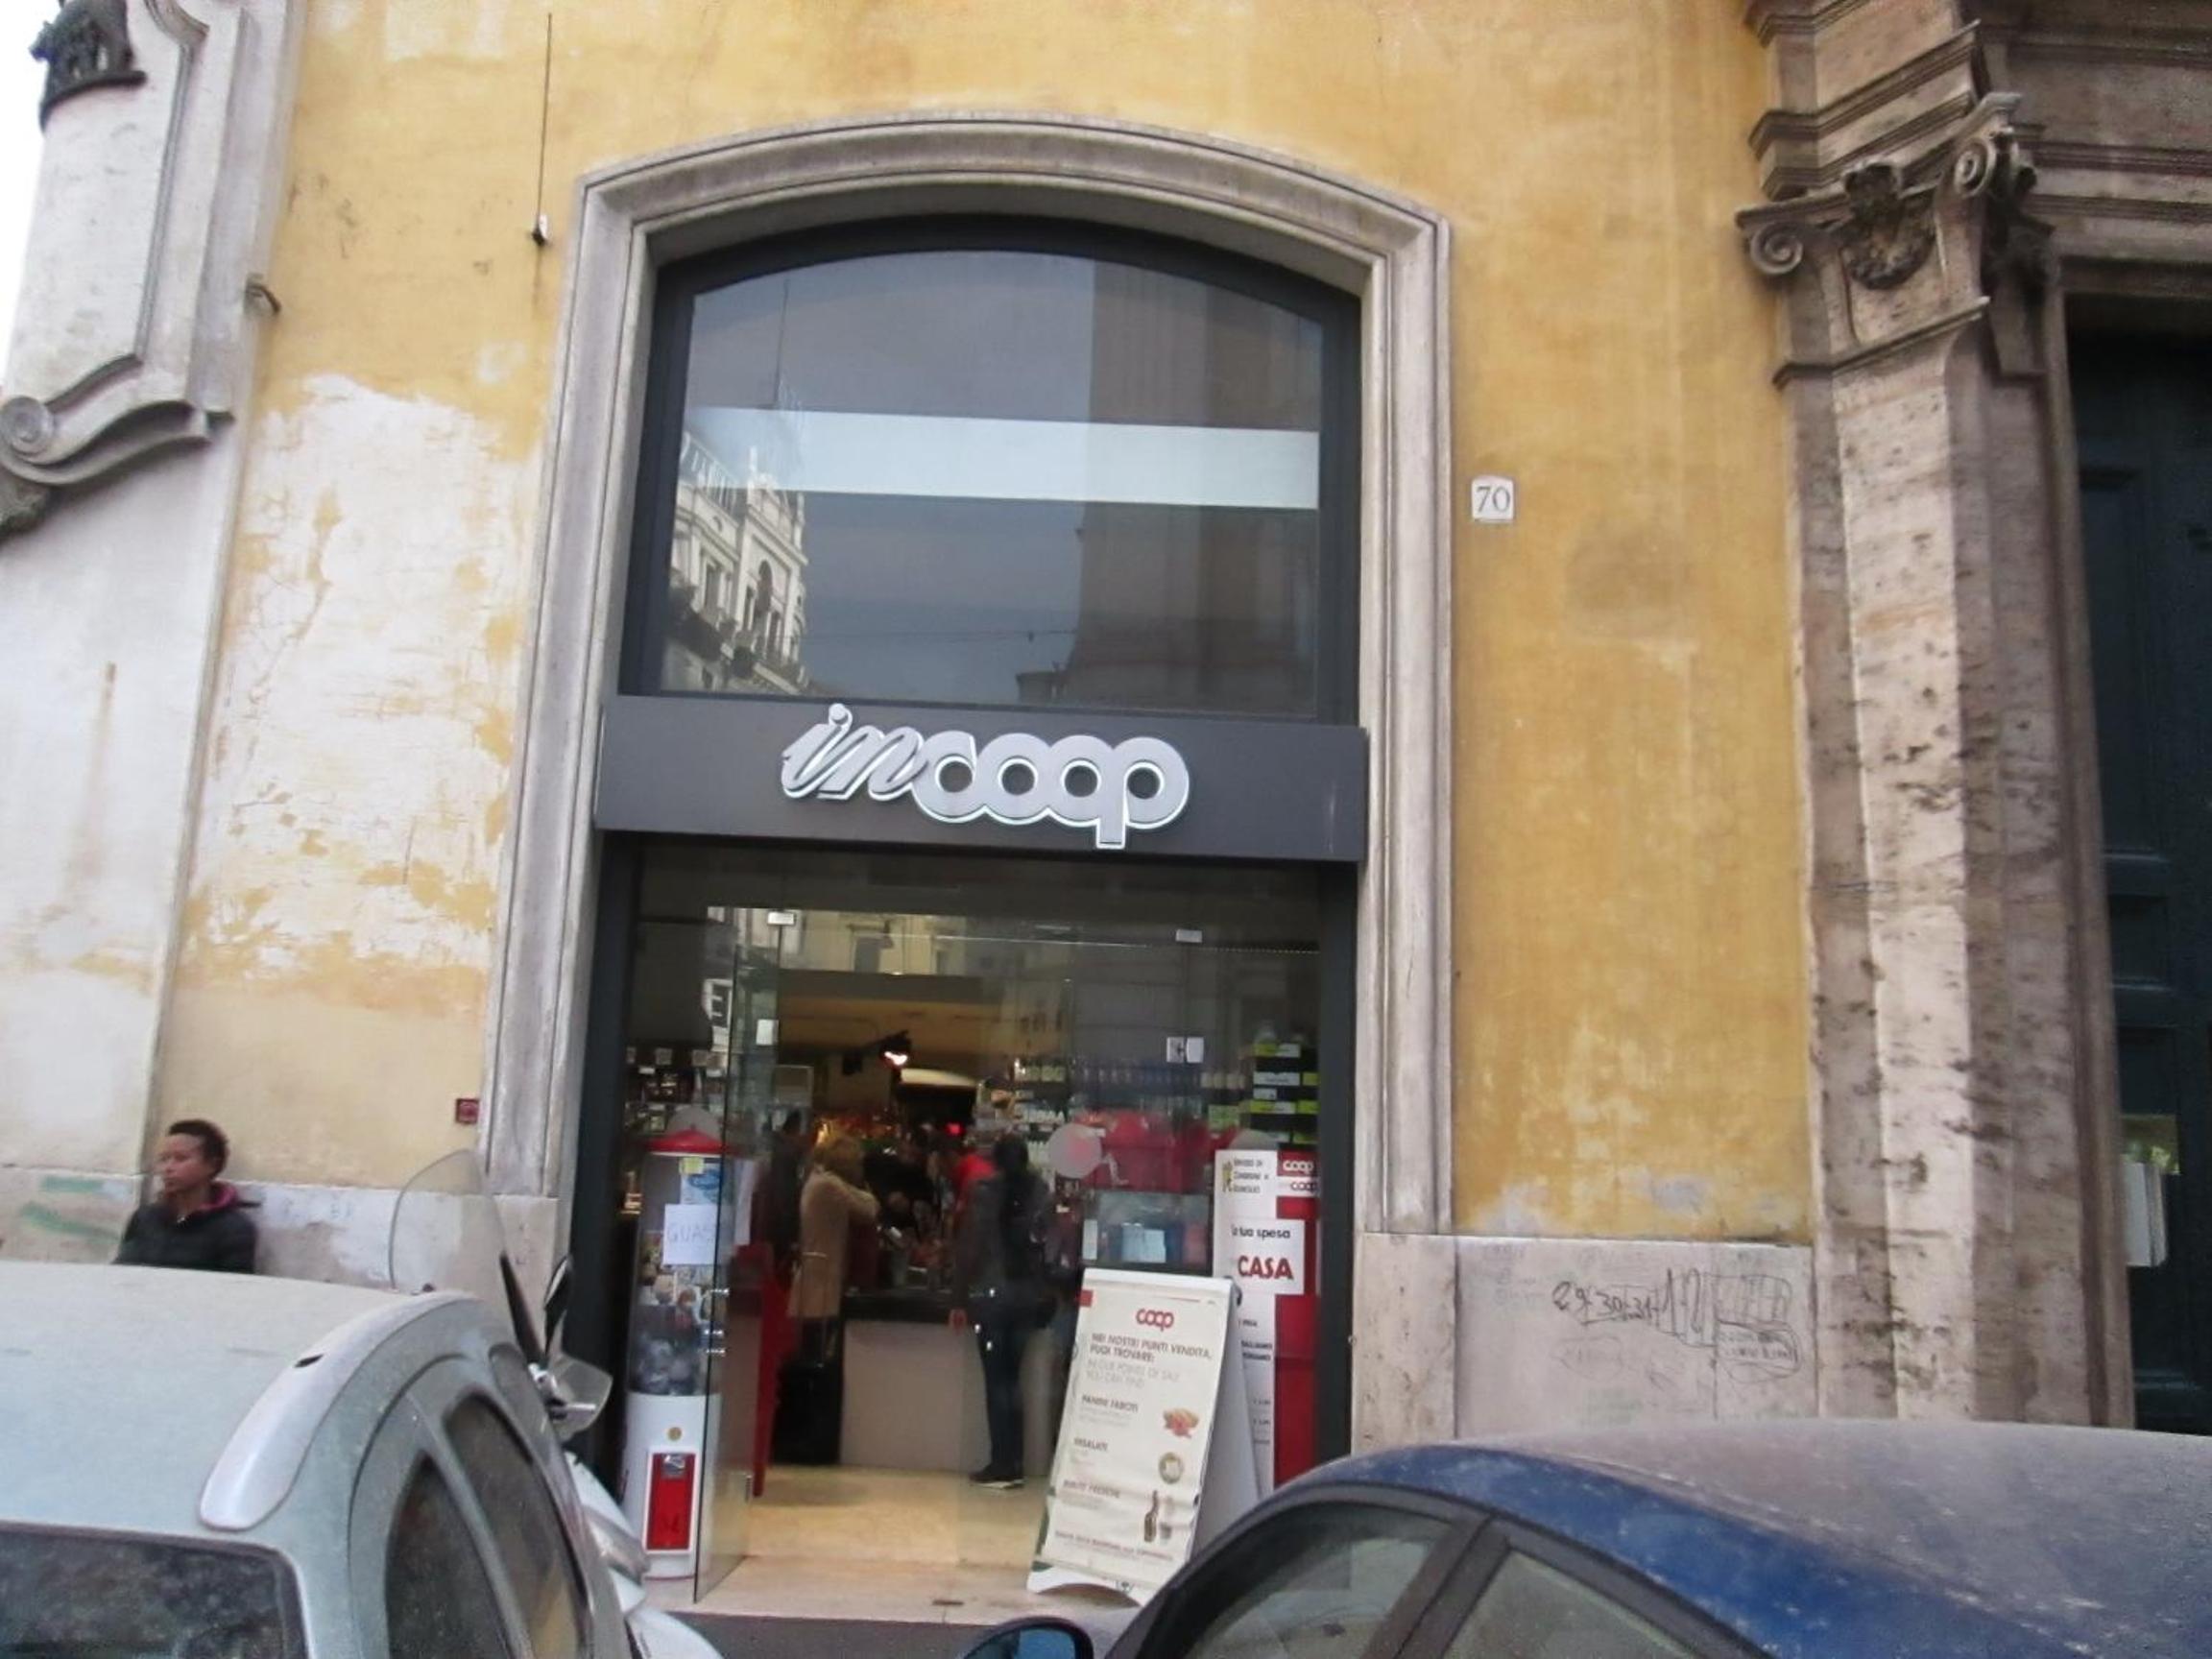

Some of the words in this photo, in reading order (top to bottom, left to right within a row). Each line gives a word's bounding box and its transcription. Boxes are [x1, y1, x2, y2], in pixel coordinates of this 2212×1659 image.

[1477, 485, 1511, 513] 70
[1239, 1227, 1254, 1237] tua
[1257, 1229, 1291, 1240] spesa
[1238, 1255, 1294, 1280] CASA
[1136, 1308, 1174, 1332] coop
[1107, 1334, 1140, 1346] NOSTRI
[1142, 1338, 1168, 1352] PUNTI
